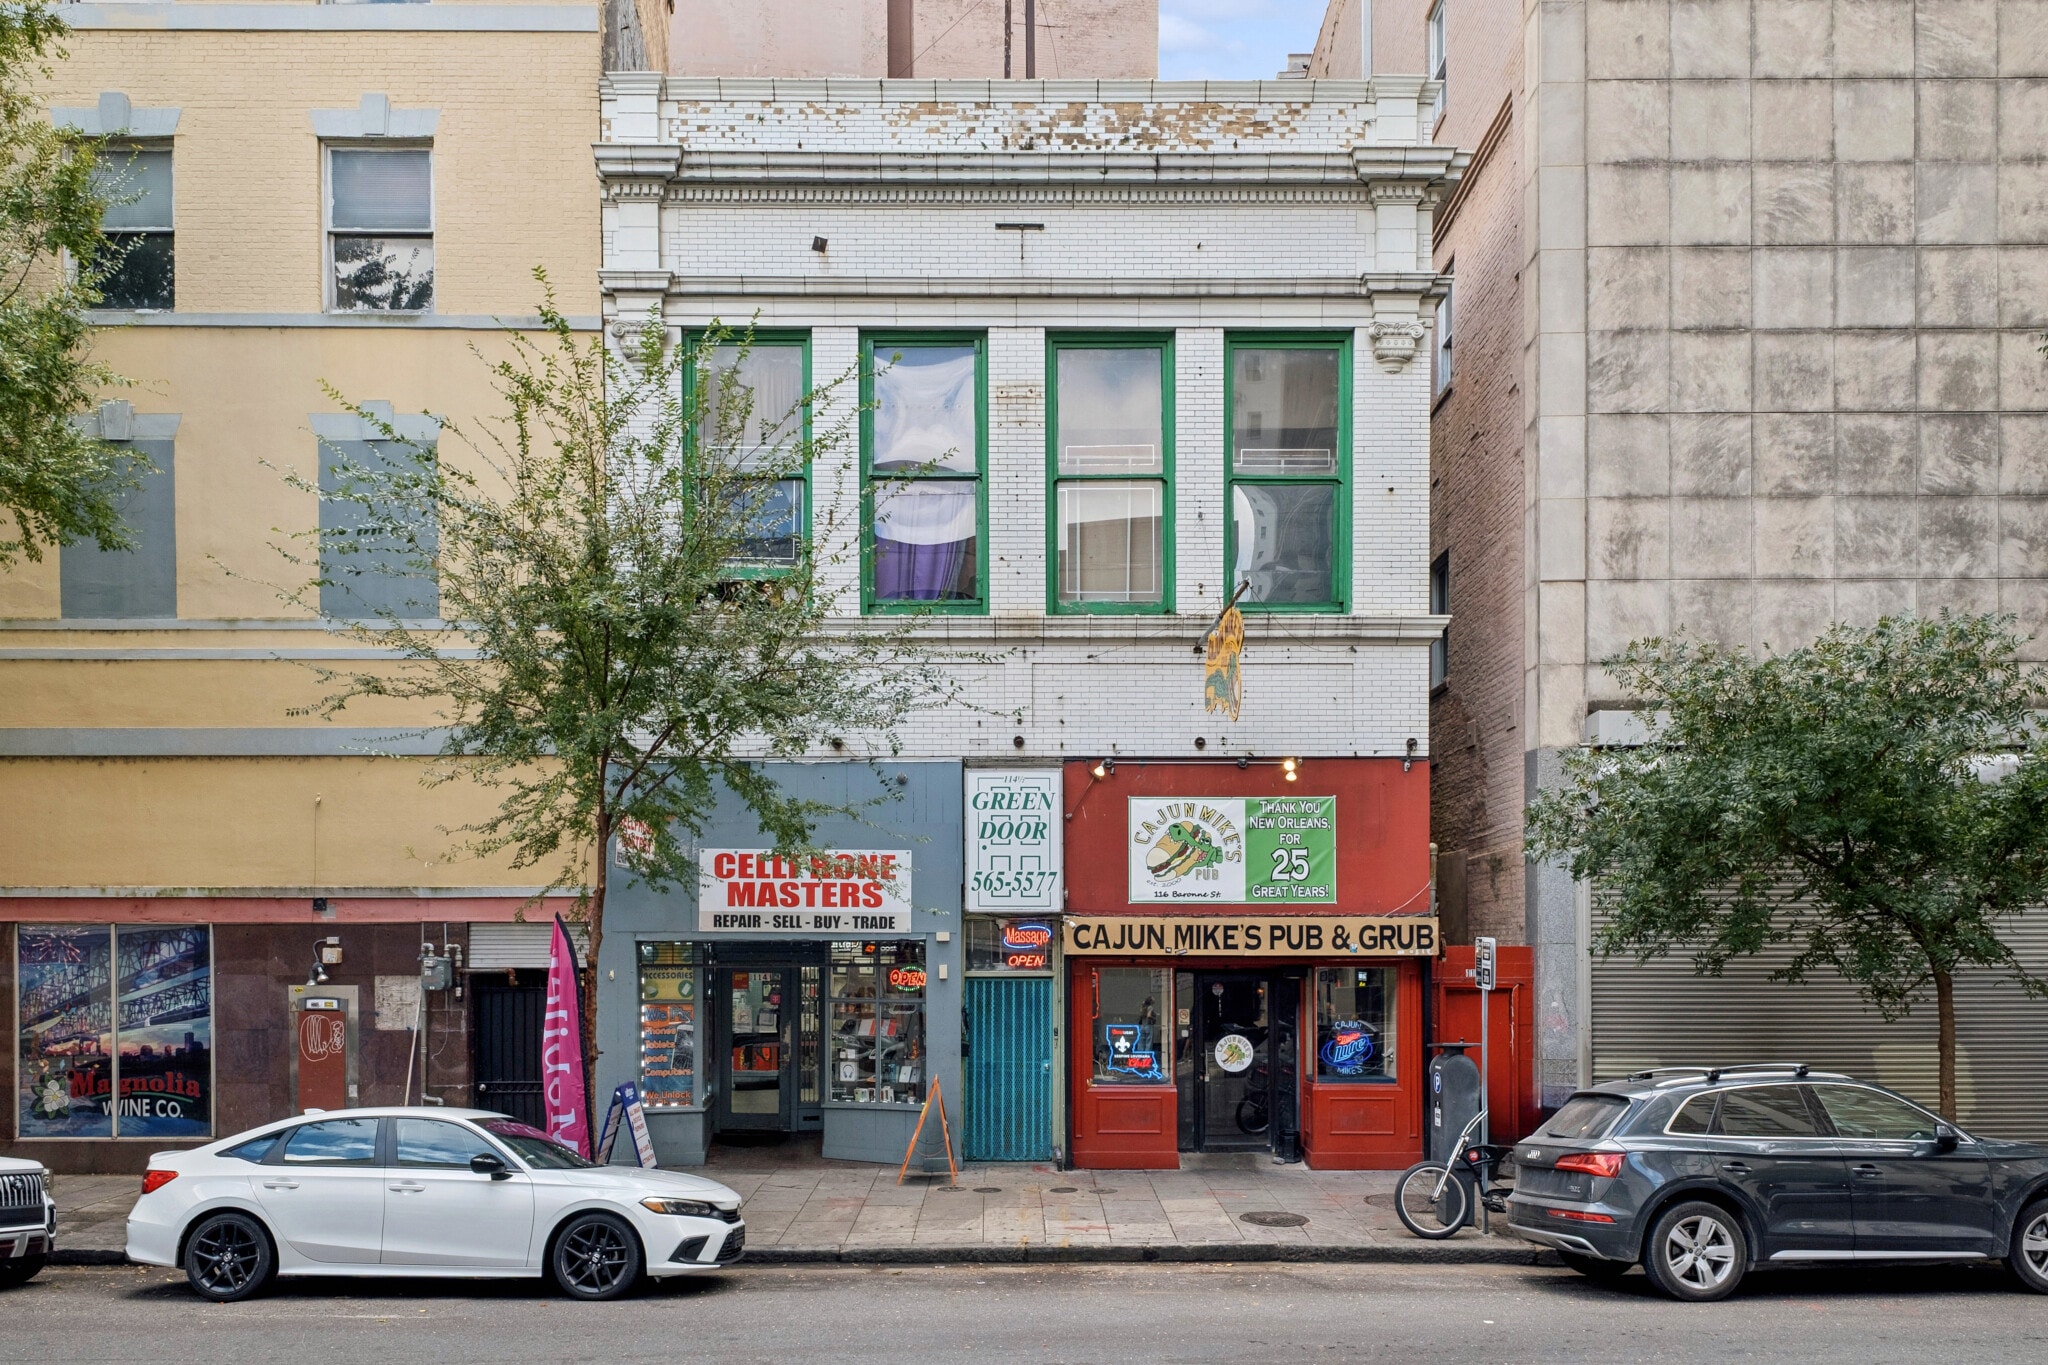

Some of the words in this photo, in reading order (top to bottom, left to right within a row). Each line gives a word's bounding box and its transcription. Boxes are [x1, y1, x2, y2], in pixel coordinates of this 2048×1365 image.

[972, 792, 1055, 811] GREEN
[1260, 800, 1297, 814] THANK
[1299, 800, 1321, 814] YOU
[979, 821, 1048, 840] DOOR
[1249, 816, 1275, 829] NEW
[1277, 816, 1331, 831] ORLEANS,
[1134, 803, 1195, 845] CAJUN
[1199, 805, 1242, 863] MIKE'S
[1279, 833, 1301, 845] FOR
[1271, 847, 1310, 882] 25
[971, 871, 1058, 892] 565-5577
[1195, 868, 1219, 881] PUB
[727, 882, 883, 908] MASTERS
[1252, 884, 1289, 898] GREAT
[1290, 884, 1330, 898] YEARS!
[713, 915, 761, 928] REPAIR
[772, 915, 802, 929] SELL
[814, 916, 841, 929] BUY
[852, 916, 896, 930] TRADE
[1006, 927, 1049, 946] Massage
[1073, 924, 1165, 949] CAJUN
[1174, 924, 1262, 950] MIKE'S
[1269, 924, 1323, 950] PUB
[1331, 924, 1352, 950] &
[1358, 924, 1435, 950] GRUB
[1008, 955, 1045, 967] OPEN
[890, 969, 927, 986] OPEN
[645, 1008, 667, 1020] We
[645, 1027, 677, 1035] Phones
[645, 1041, 676, 1049] Tablets
[68, 1069, 201, 1099] Magnolia
[646, 1091, 659, 1099] We
[661, 1090, 691, 1099] Unlock
[102, 1098, 150, 1117] WINE
[155, 1100, 184, 1118] CO.
